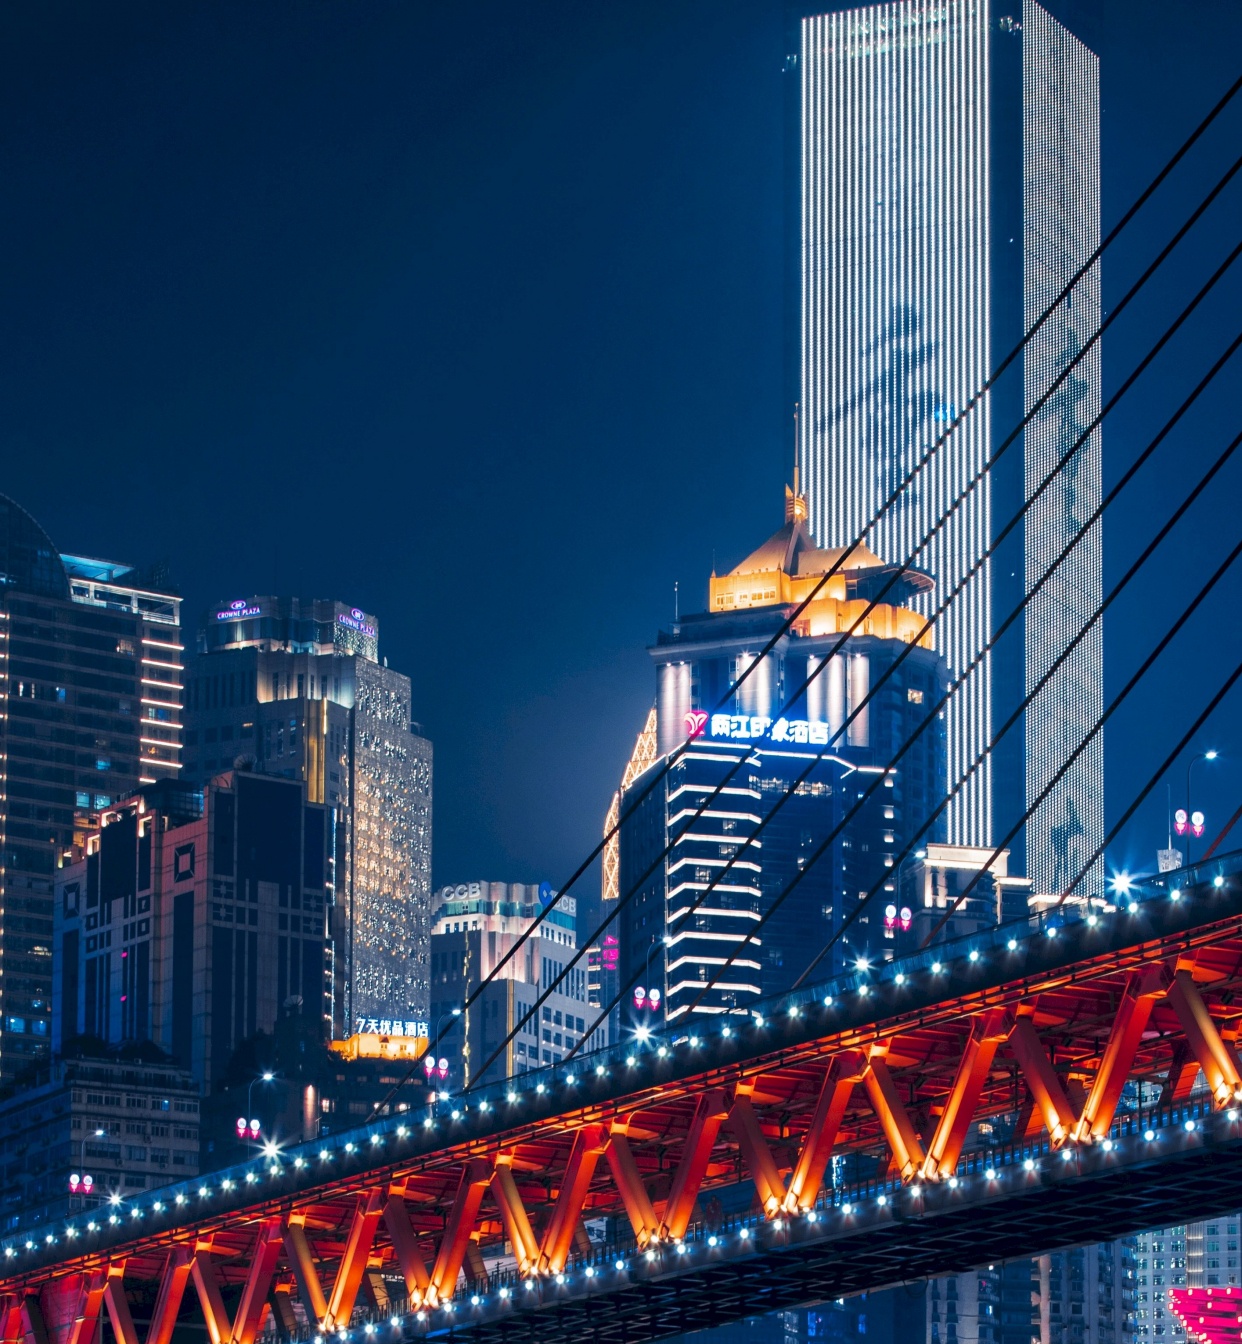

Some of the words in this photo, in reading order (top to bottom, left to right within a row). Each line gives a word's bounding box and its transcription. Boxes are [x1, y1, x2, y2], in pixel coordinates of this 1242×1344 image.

[217, 609, 241, 620] CROWNE
[242, 606, 261, 616] PLAZA
[338, 613, 360, 631] CROWNE
[360, 622, 376, 637] PLAZA
[711, 713, 829, 744] 两江印象酒店
[441, 882, 482, 901] CCB
[356, 1018, 429, 1038] 7天优品酒店
